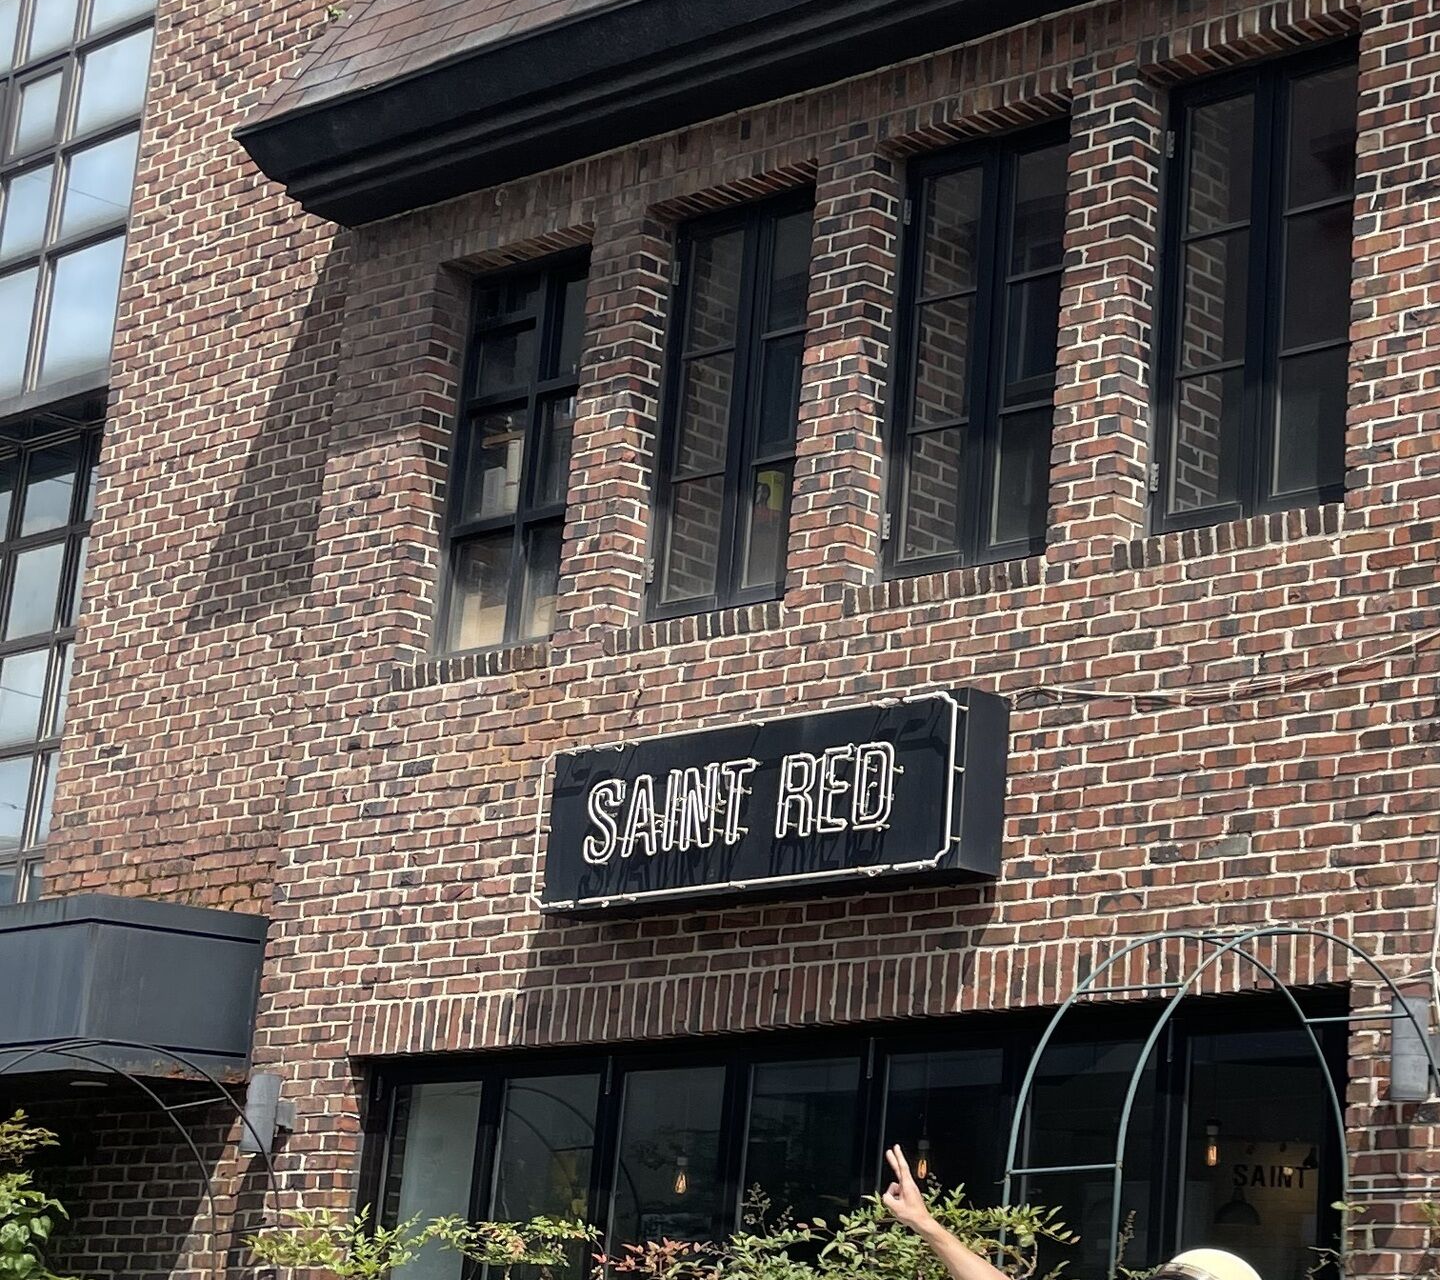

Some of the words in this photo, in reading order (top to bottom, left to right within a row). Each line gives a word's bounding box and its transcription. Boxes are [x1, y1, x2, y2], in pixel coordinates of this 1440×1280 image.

[583, 758, 761, 864] SAINT
[775, 742, 896, 838] RED
[1233, 1164, 1309, 1189] SAINT
